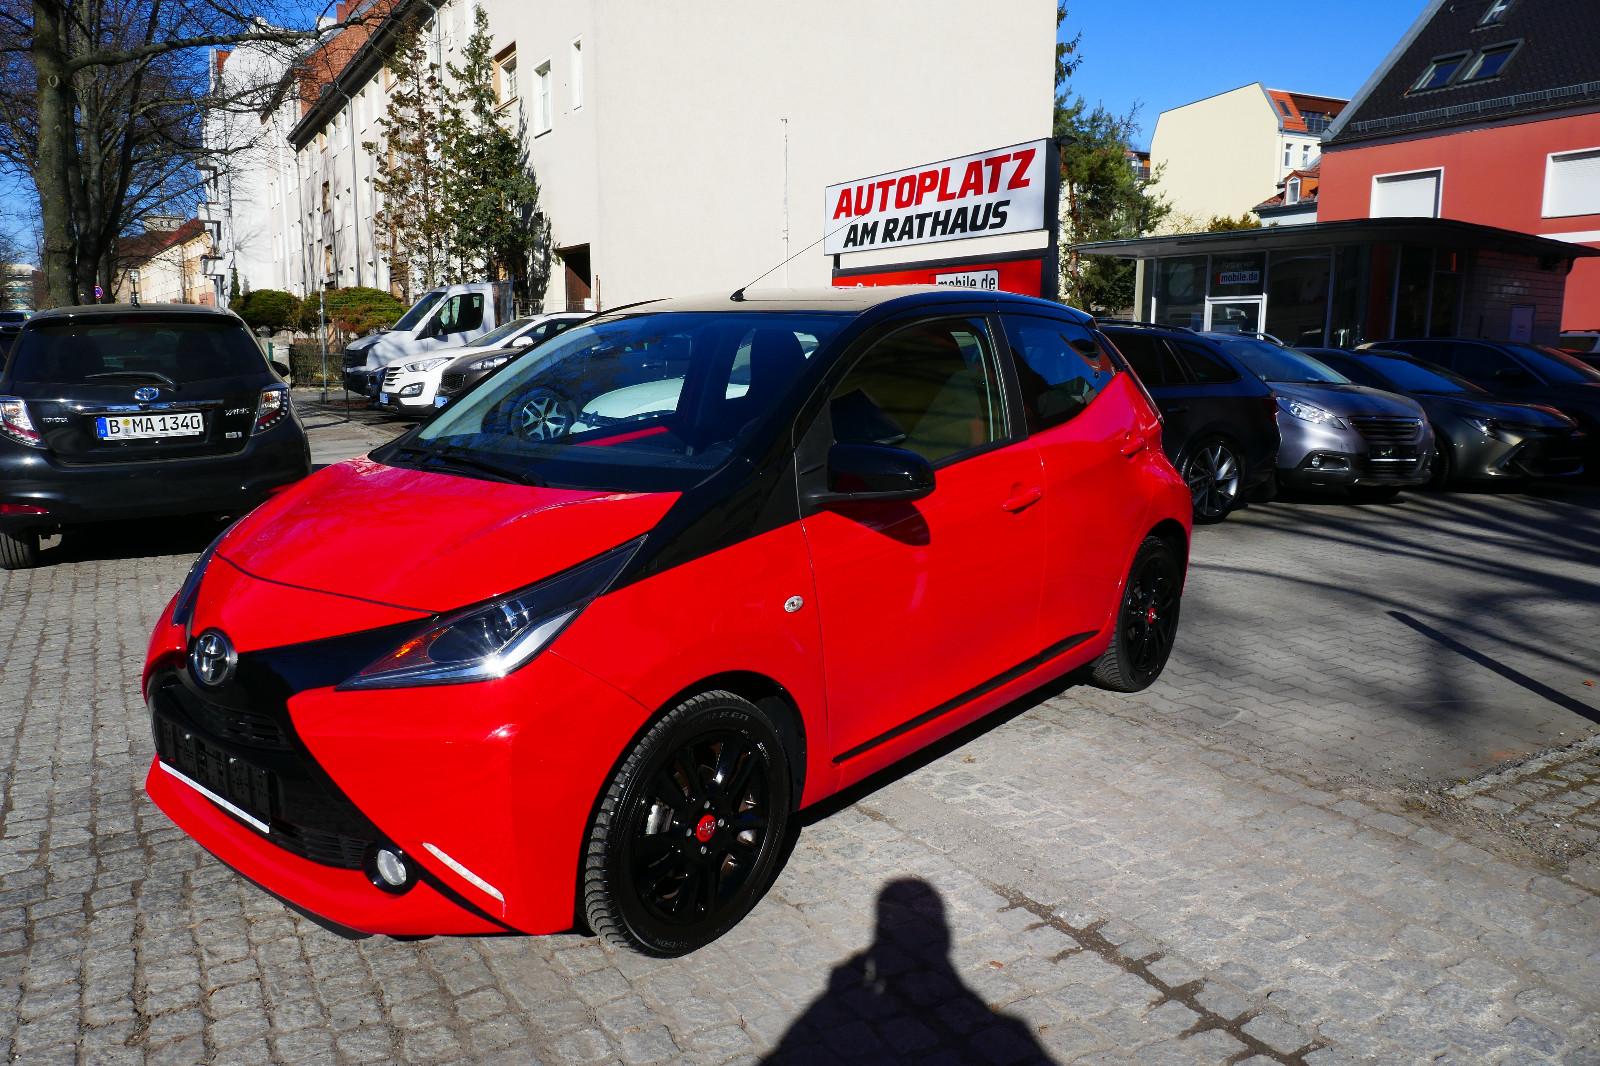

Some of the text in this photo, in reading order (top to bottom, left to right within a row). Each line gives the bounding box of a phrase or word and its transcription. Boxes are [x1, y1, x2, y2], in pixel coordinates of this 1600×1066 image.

[832, 148, 1036, 220] AUTOPLATZ
[843, 200, 1011, 248] AM RATHAUS
[937, 273, 996, 290] obilede
[109, 419, 121, 434] B
[132, 417, 155, 433] MA
[158, 415, 201, 432] 1340
